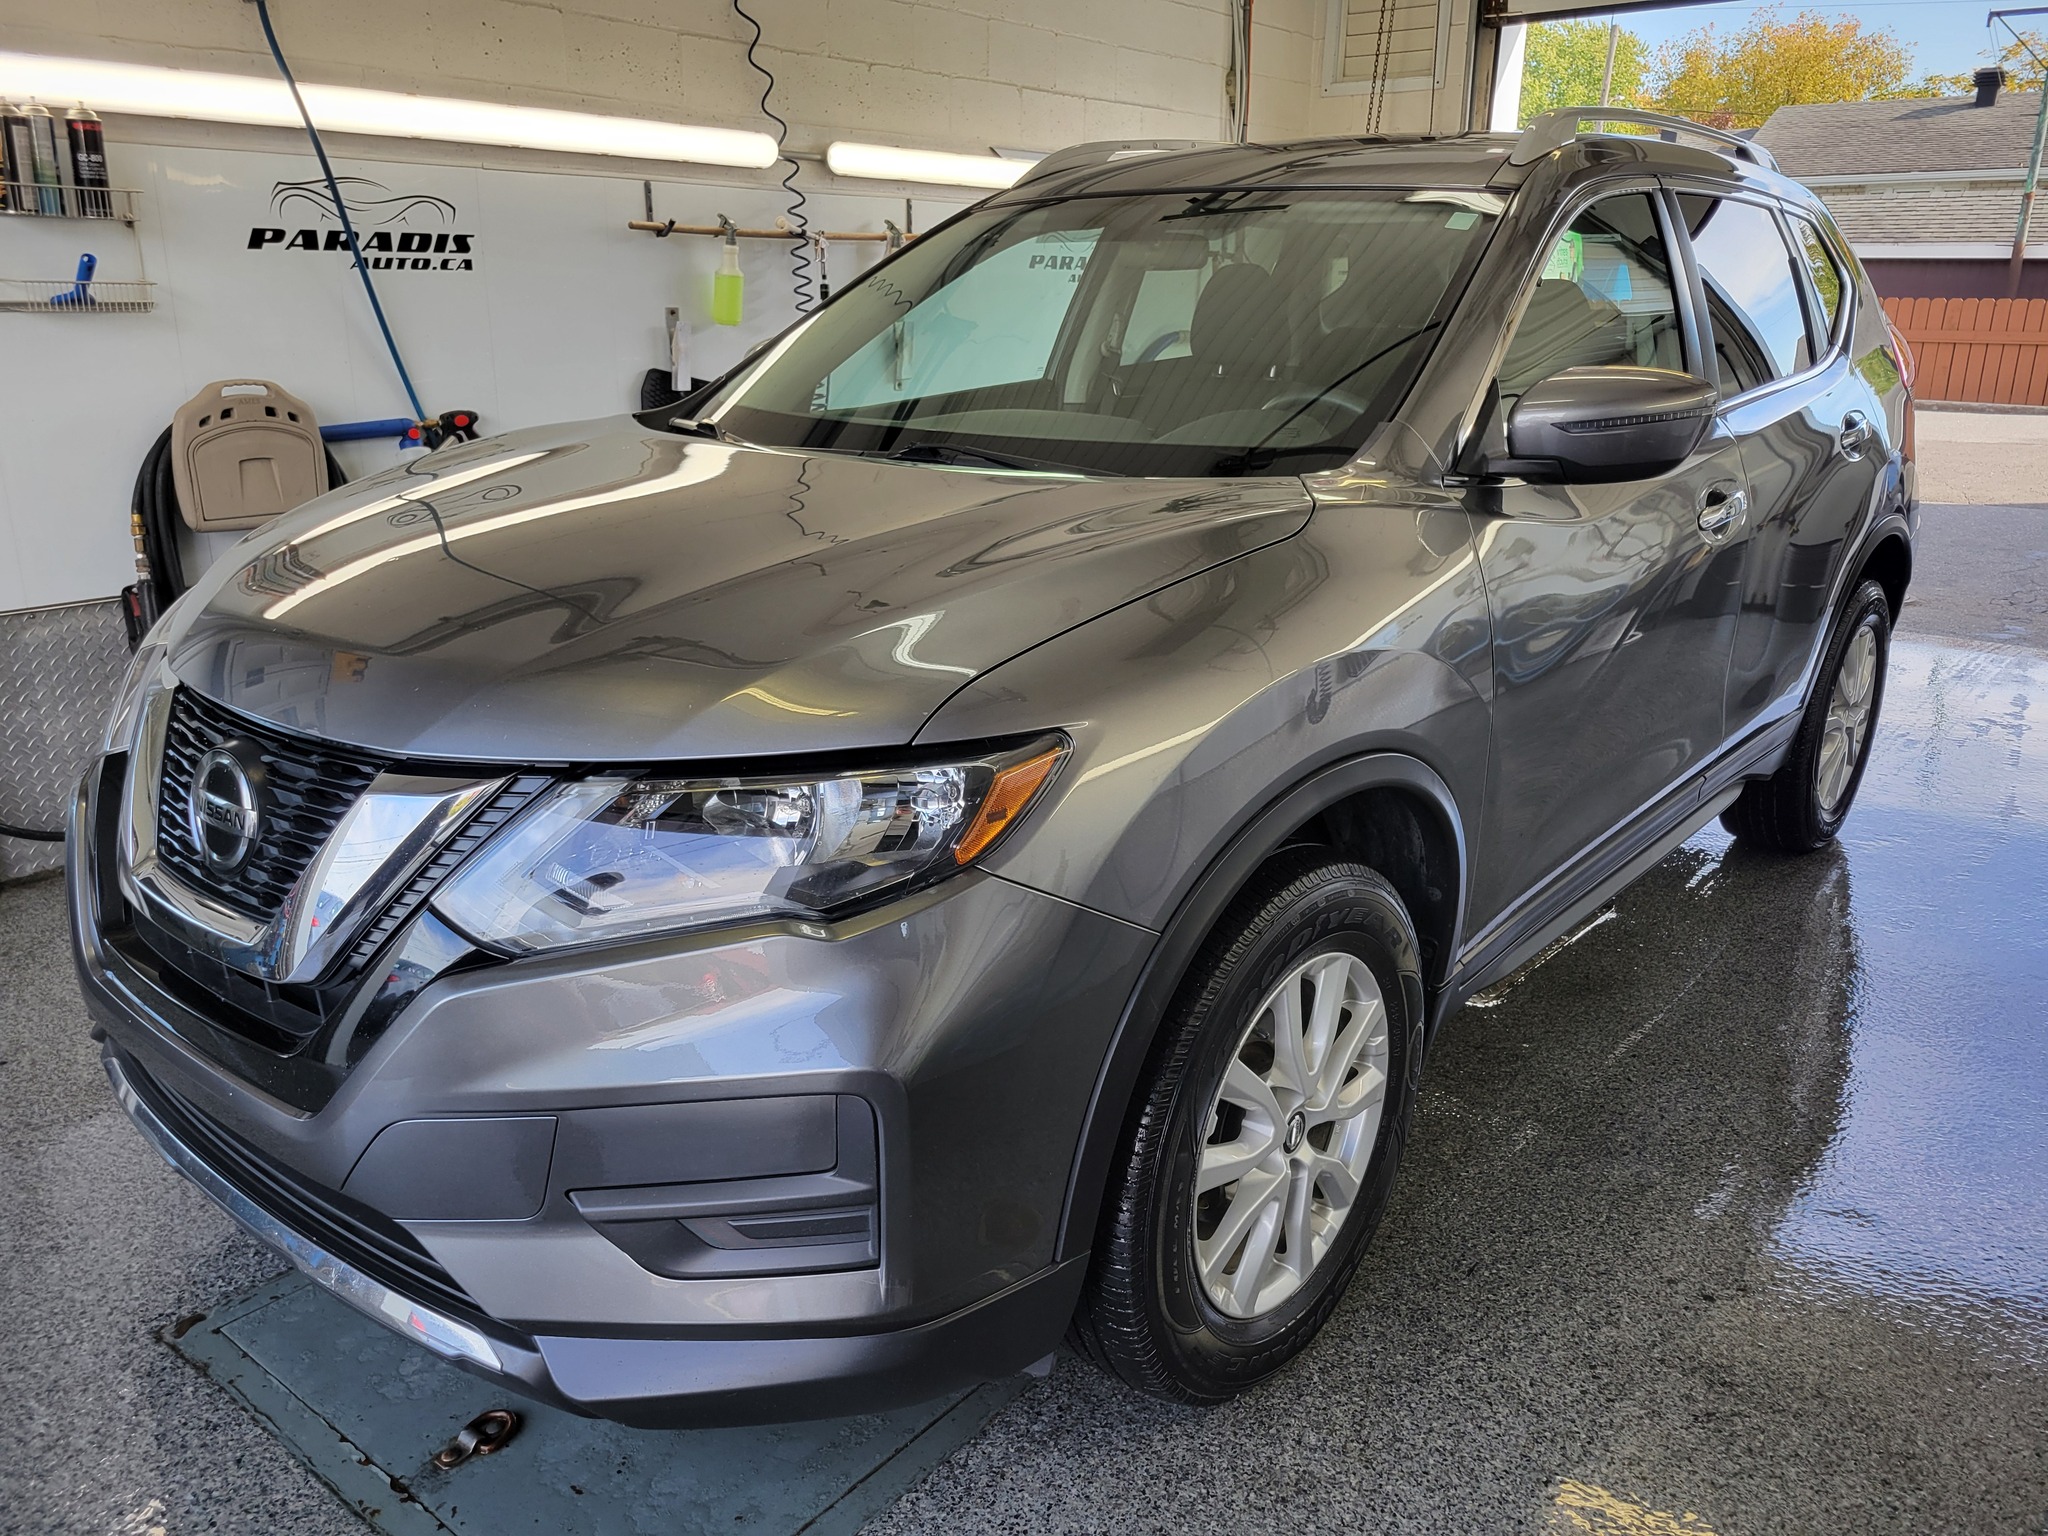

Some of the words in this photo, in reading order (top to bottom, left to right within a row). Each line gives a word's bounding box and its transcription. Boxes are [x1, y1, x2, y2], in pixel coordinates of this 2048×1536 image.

[247, 227, 475, 254] PARADIS
[350, 256, 474, 271] AUTO.CA
[1028, 254, 1088, 270] PARA
[1212, 906, 1404, 1072] GOODYEAR
